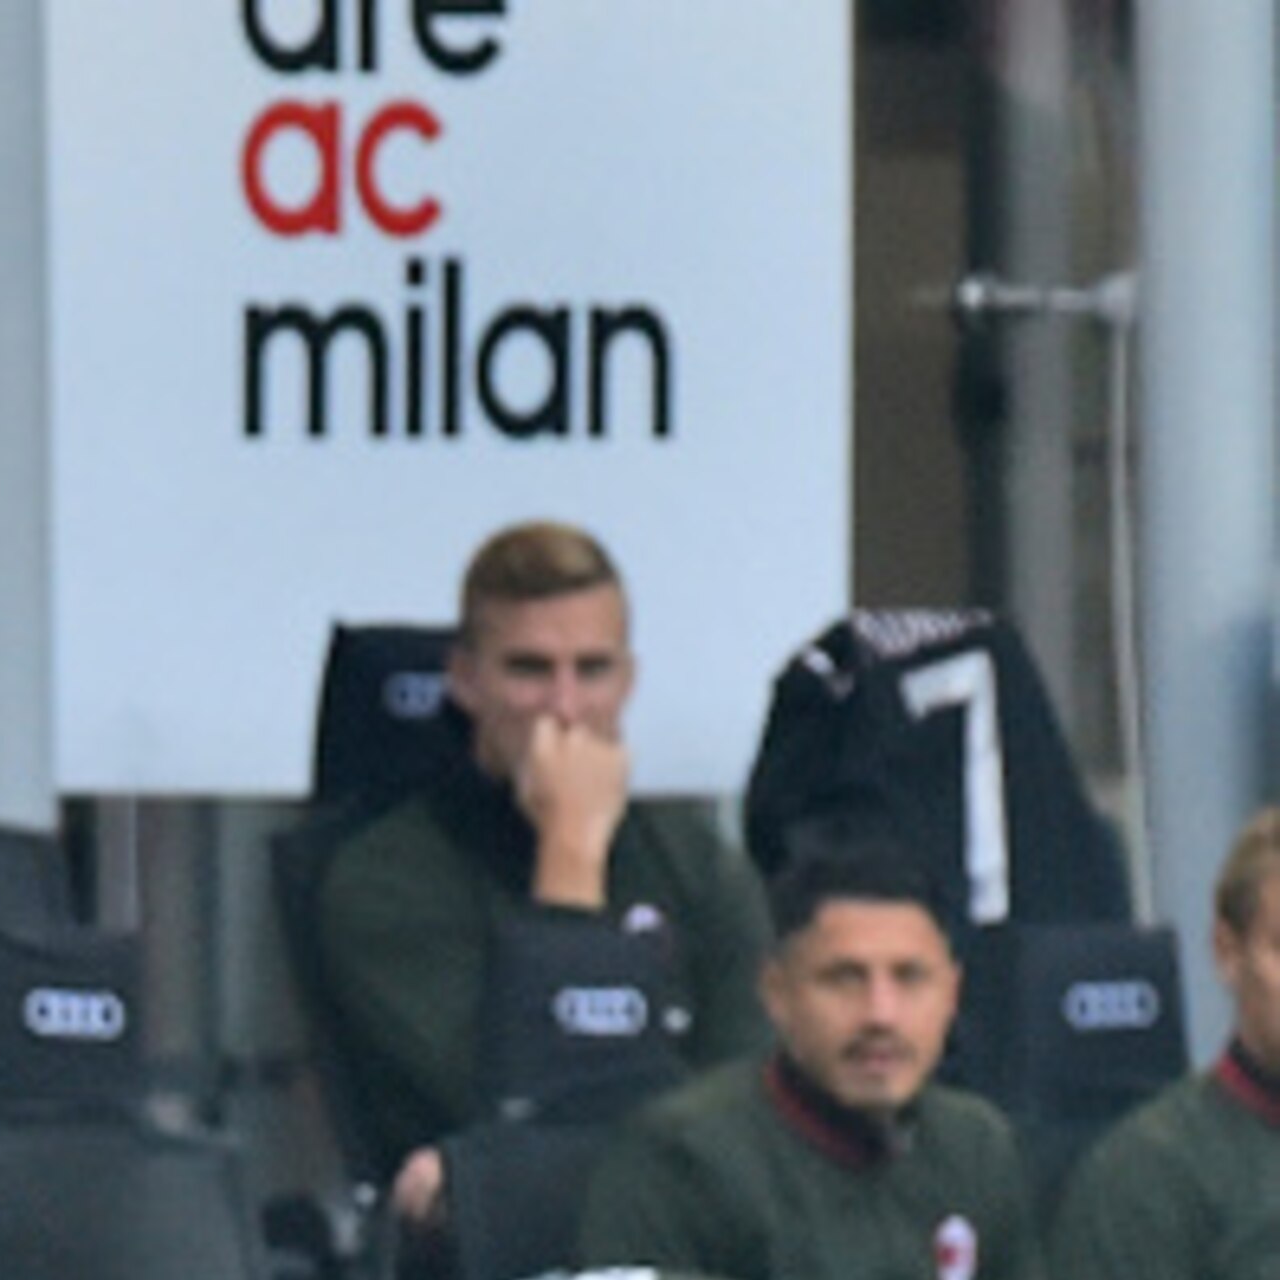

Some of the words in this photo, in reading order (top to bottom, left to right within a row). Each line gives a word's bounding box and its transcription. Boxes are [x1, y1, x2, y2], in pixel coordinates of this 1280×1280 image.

[241, 97, 443, 239] ac
[243, 256, 674, 439] milan
[899, 649, 1011, 927] 7
